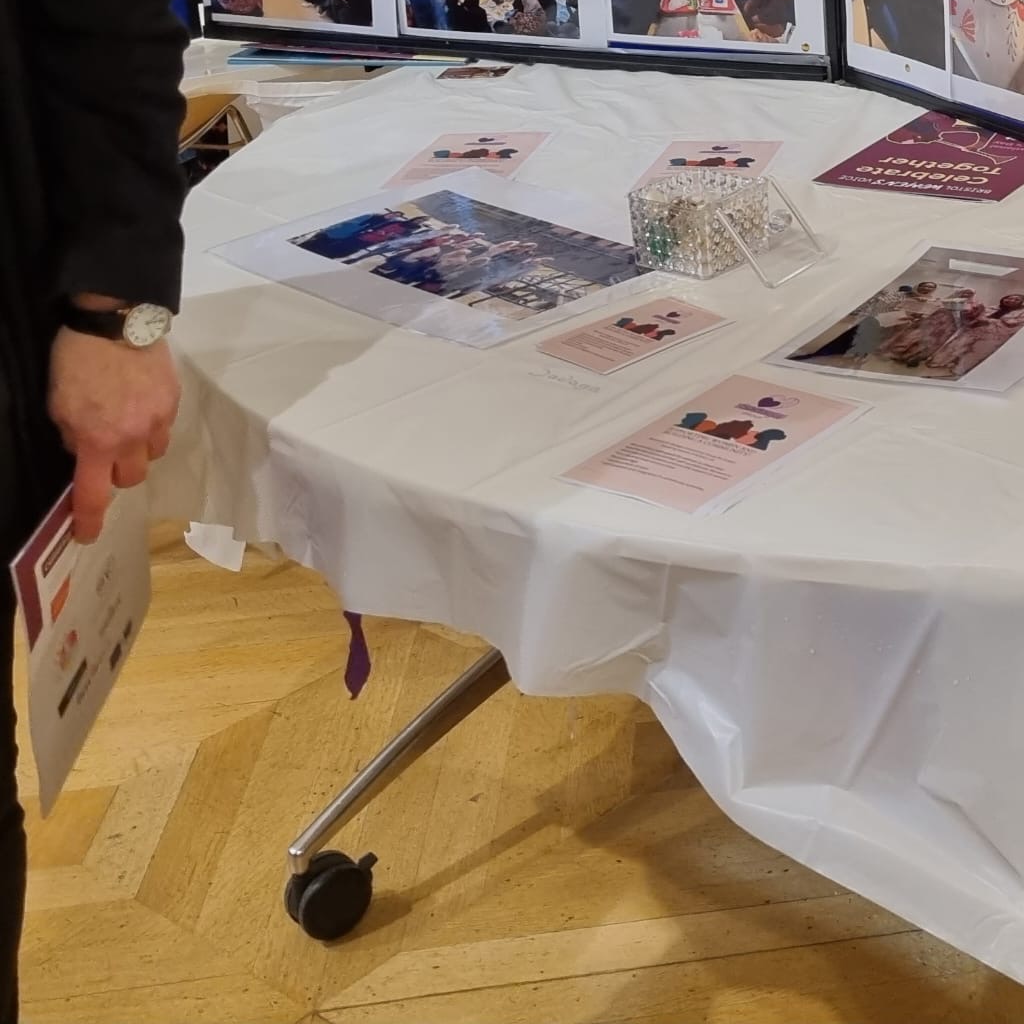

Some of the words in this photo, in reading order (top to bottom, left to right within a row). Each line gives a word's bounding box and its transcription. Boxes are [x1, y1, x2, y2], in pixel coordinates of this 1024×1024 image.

[856, 164, 989, 186] Celebrate
[878, 156, 1002, 176] Together
[946, 184, 992, 195] BRISTOL
